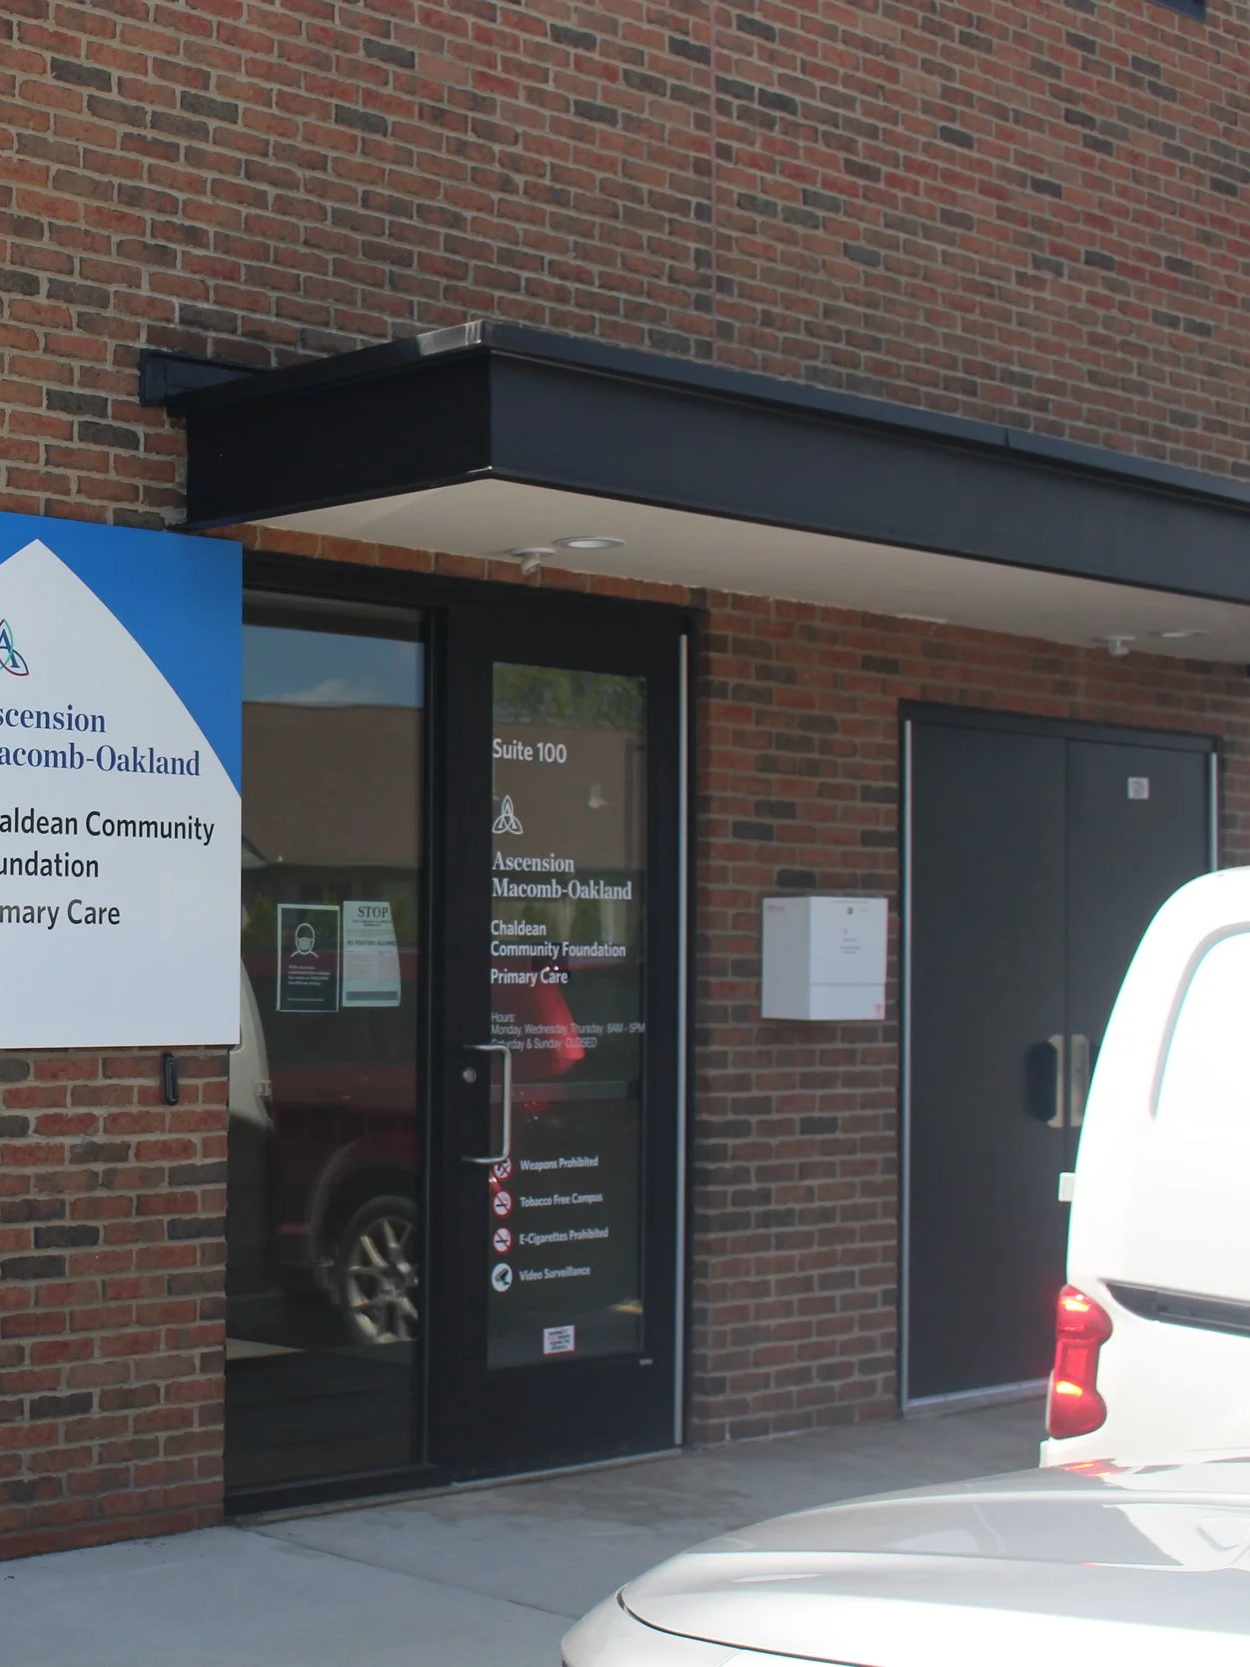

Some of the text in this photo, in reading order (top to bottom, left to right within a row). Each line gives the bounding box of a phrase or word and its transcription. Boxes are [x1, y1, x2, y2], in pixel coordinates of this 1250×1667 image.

[492, 738, 567, 763] Suite 100
[85, 810, 215, 846] Community
[492, 851, 575, 873] Ascension
[492, 877, 632, 900] Macomb-Oakland
[67, 899, 121, 925] Care
[357, 905, 389, 918] STOP
[490, 919, 547, 936] Chaldean
[490, 941, 626, 960] Community Foundation
[490, 968, 568, 987] Primary Care
[491, 1011, 516, 1023] Hours:
[526, 1038, 532, 1049] &
[565, 1036, 598, 1049] CLOSED
[520, 1156, 599, 1172] Weapons Prohibited
[519, 1193, 604, 1208] Tobacco Free Campus
[519, 1227, 609, 1246] E-Cigarettes Prohibited
[519, 1266, 591, 1281] Video Surveillance
